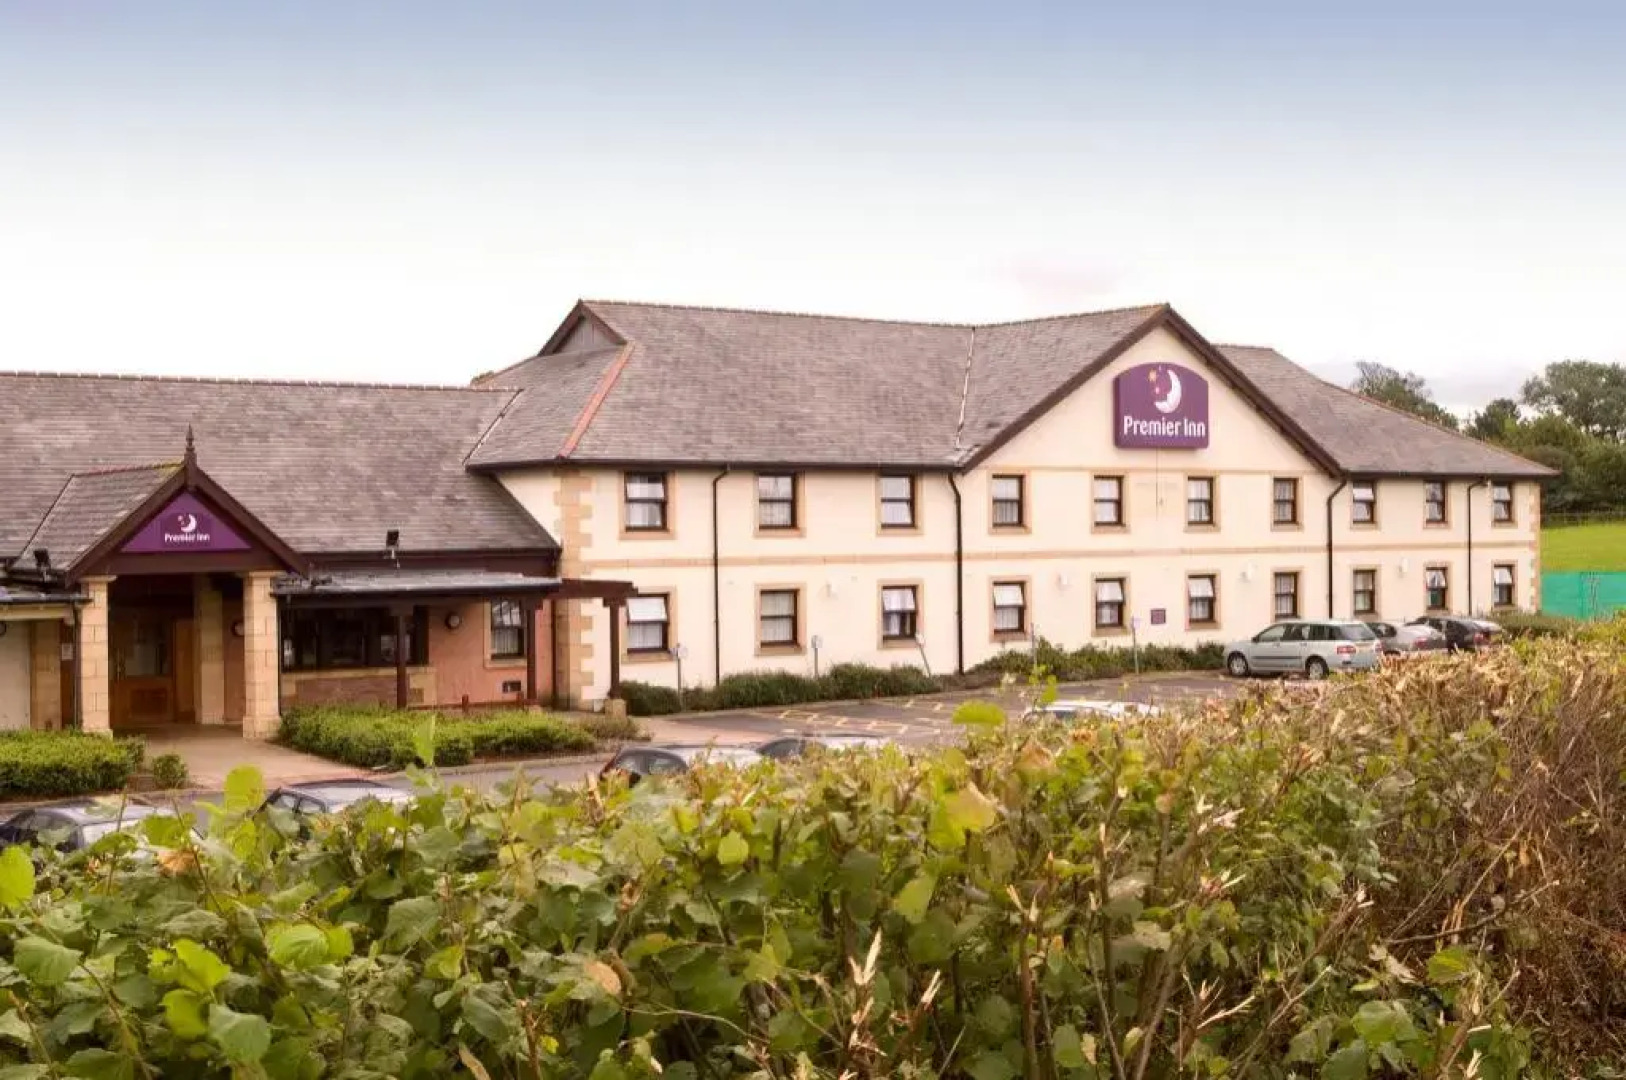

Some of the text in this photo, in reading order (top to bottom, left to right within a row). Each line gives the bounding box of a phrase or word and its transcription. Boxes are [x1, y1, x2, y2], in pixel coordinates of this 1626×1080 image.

[1123, 415, 1206, 437] Premier Inn
[164, 532, 210, 542] Premier Inn
